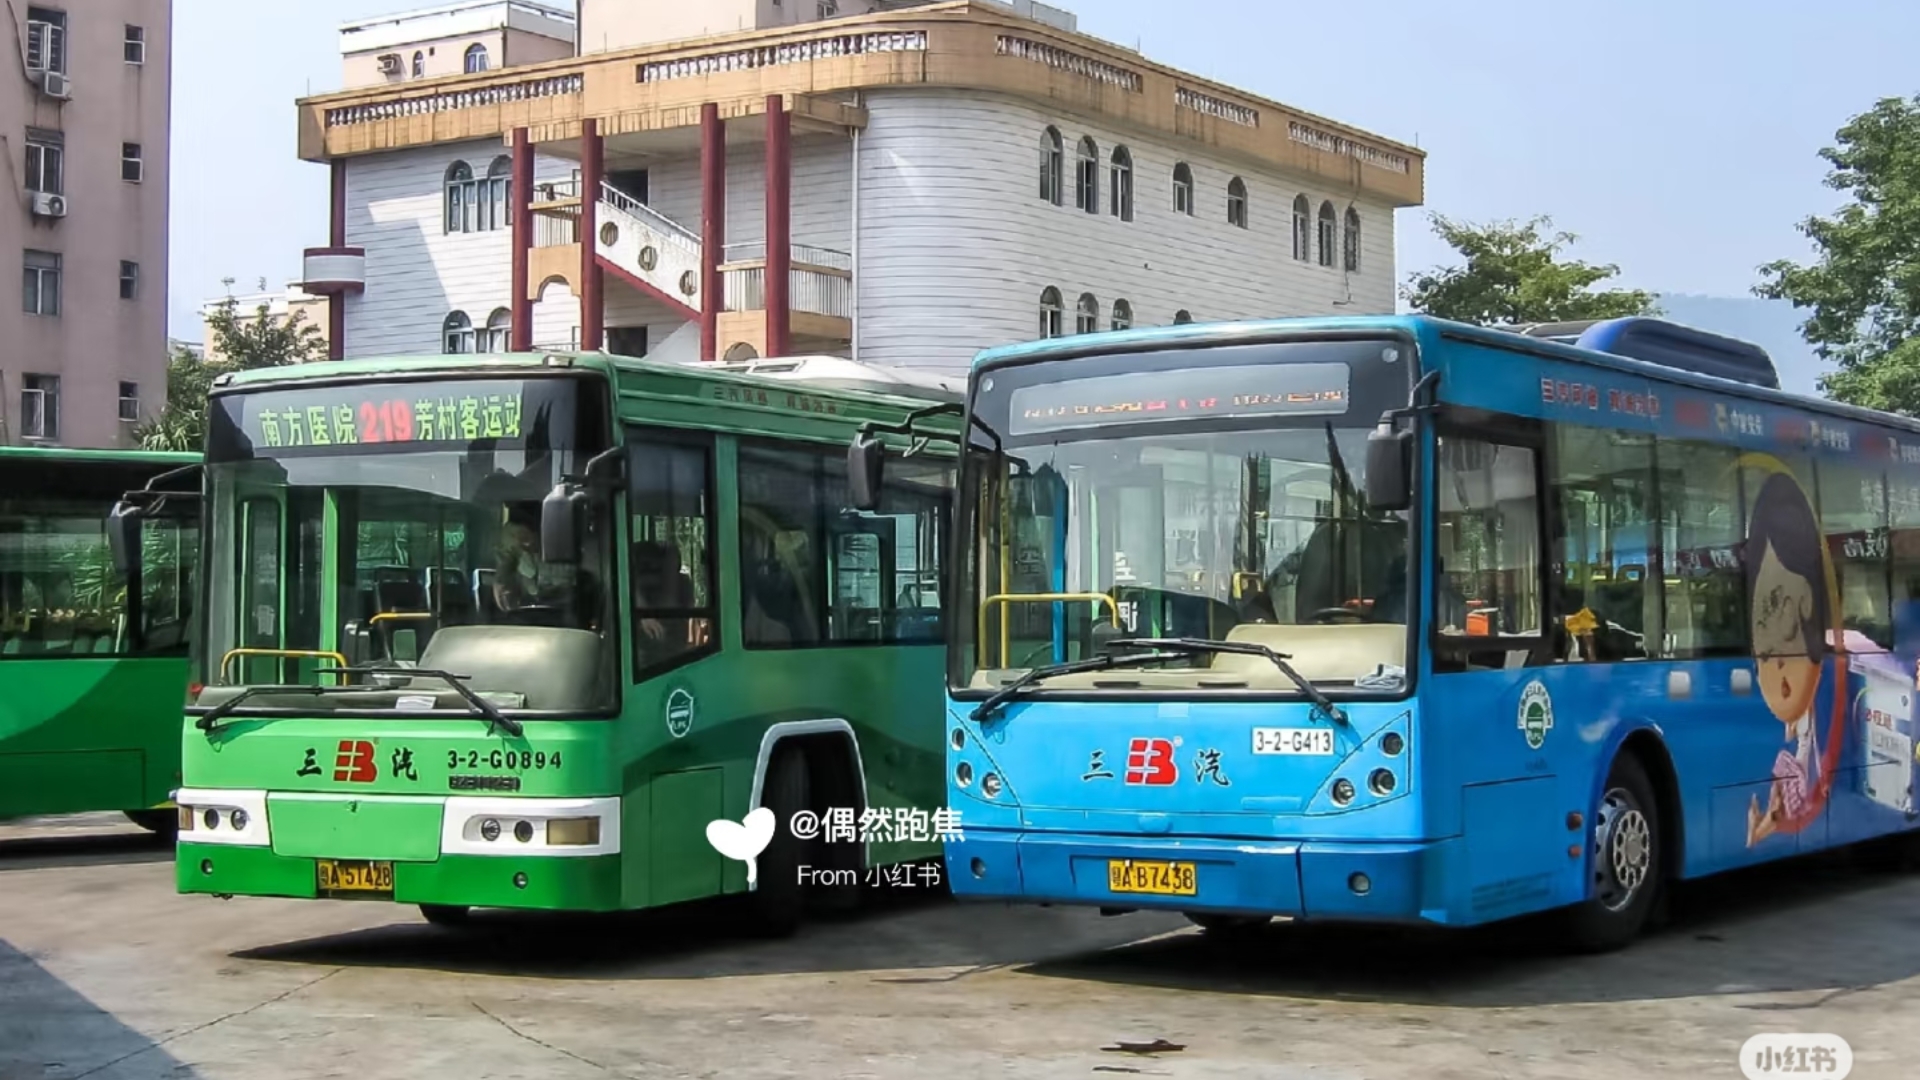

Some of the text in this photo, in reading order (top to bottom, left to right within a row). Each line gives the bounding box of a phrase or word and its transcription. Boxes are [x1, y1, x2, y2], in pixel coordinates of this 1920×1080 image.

[259, 393, 521, 447] 南方医院 219 芳村客运站
[1256, 731, 1331, 752] 3-2-G413
[296, 748, 322, 777] 三
[391, 747, 418, 781] 汽
[447, 749, 562, 769] 3-2-G0894
[1082, 750, 1114, 781] 三
[1193, 748, 1230, 786] 汽
